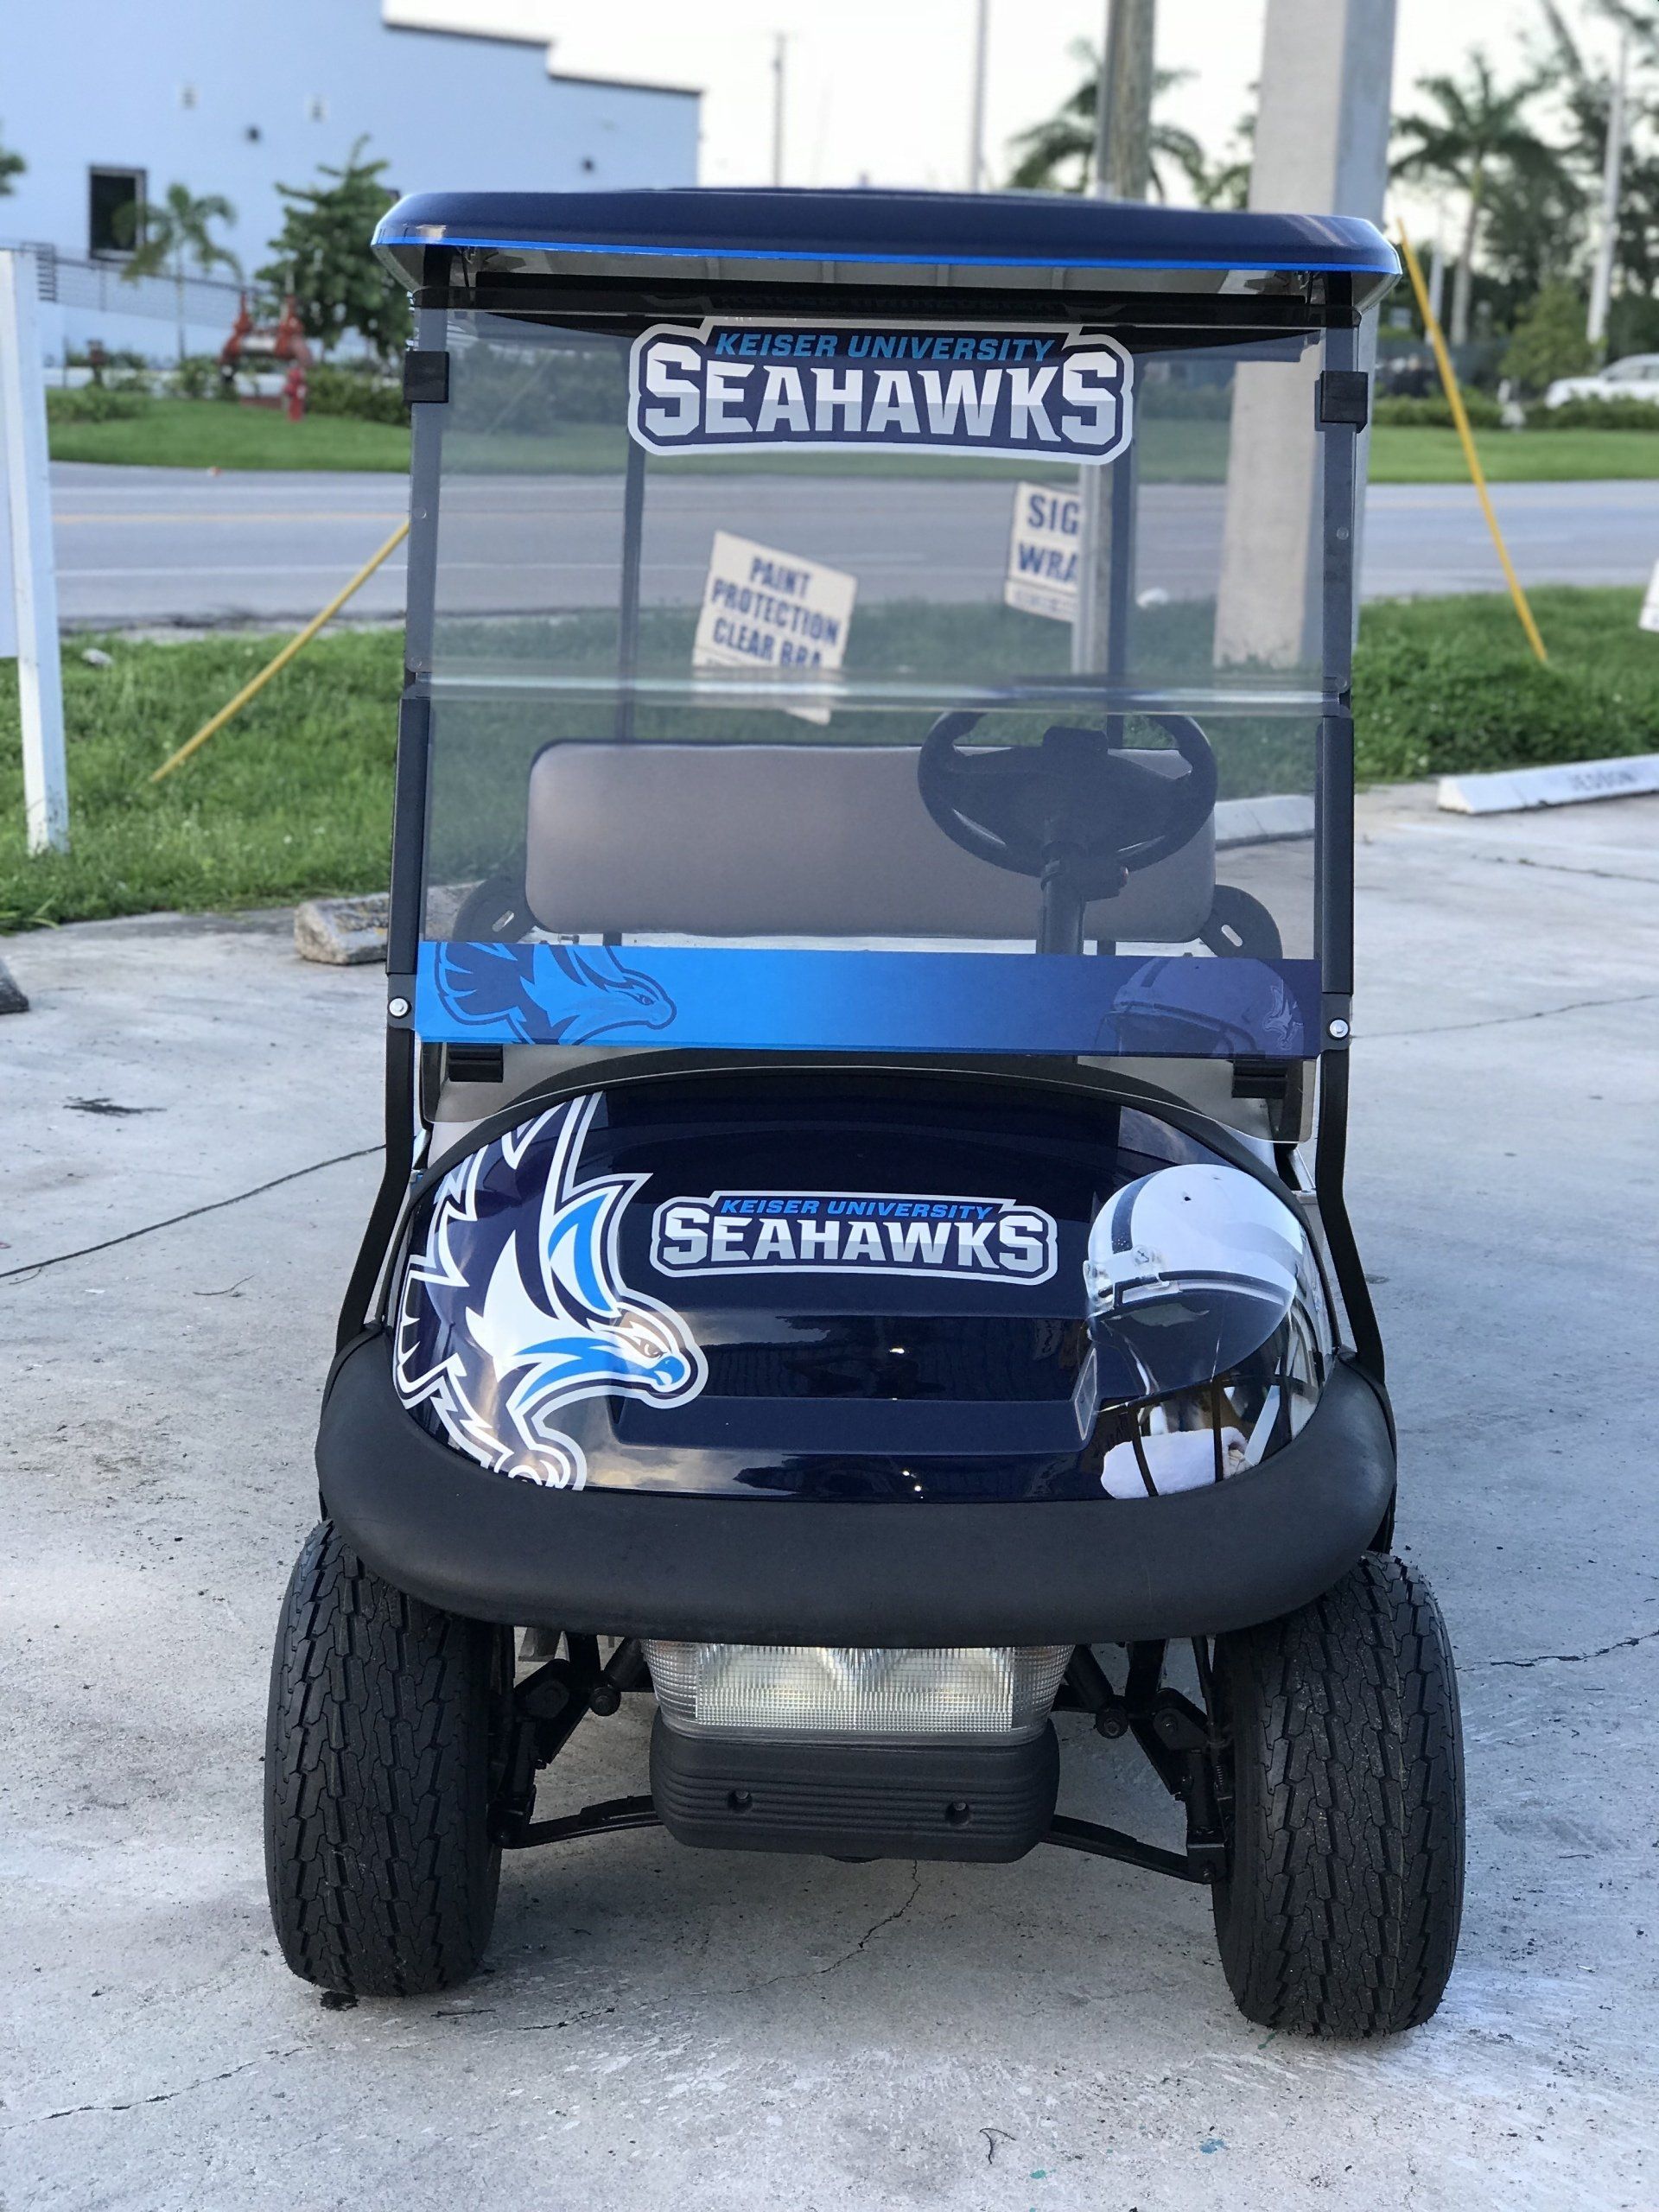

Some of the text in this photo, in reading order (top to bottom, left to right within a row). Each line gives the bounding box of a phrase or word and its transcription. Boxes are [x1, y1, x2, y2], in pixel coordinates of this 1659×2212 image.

[715, 333, 1055, 362] KEISER UNIVERSITY
[645, 342, 1117, 445] SEAHAWKS
[750, 556, 810, 599] PAINT
[711, 578, 840, 645] PROTECTION
[713, 616, 774, 661] CLEAR
[721, 1198, 993, 1220] KEISER UNIVERSITY
[663, 1206, 1043, 1273] SEAHAWKS
